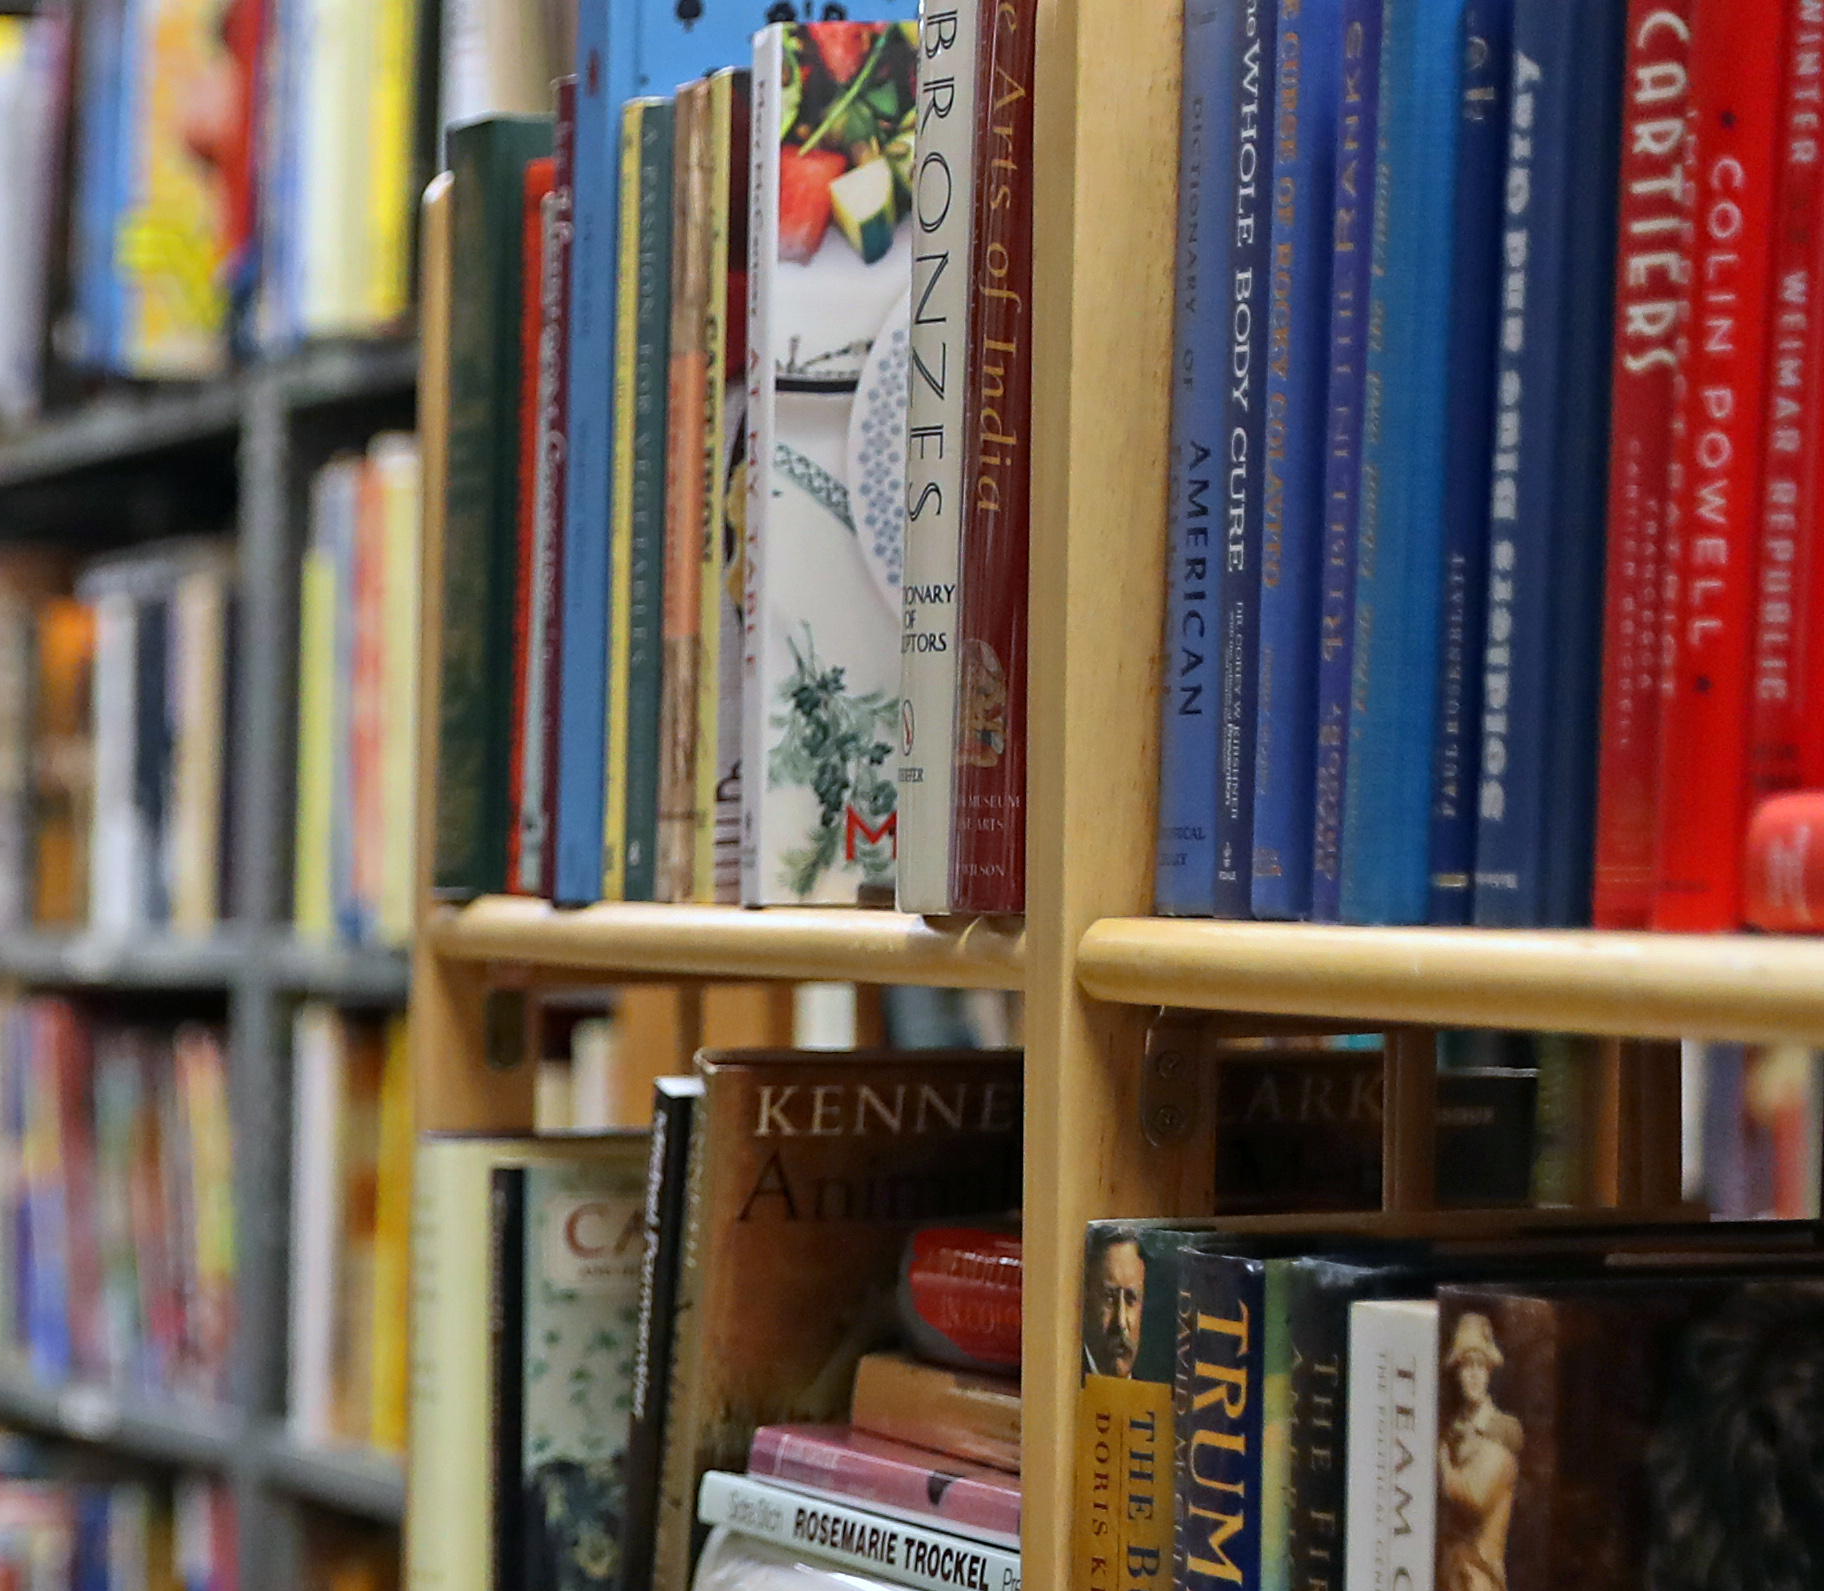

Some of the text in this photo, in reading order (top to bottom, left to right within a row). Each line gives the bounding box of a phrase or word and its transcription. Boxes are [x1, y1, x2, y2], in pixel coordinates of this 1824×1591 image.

[989, 66, 1025, 211] Arts
[1235, 39, 1260, 248] WHOLE
[1788, 0, 1822, 165] WINTER
[638, 166, 658, 325] PASSION
[908, 8, 957, 523] BRONZES
[1184, 96, 1204, 316] DICTIONARY
[1624, 9, 1690, 373] CARTIERS
[979, 242, 1021, 313] of
[1232, 268, 1253, 413] BODY
[1263, 32, 1301, 588] CURSE OF ROCKY COLAVITO
[977, 336, 1018, 513] India
[1687, 156, 1745, 647] COLIN POWELL
[1228, 427, 1248, 574] CURE
[1755, 270, 1807, 700] WEIMAR REPUBLIC
[902, 584, 956, 605] IONARY
[1179, 440, 1211, 717] AMERICAN
[754, 1081, 1016, 1137] KENNE
[1174, 1288, 1194, 1416] DAVID
[1310, 1353, 1340, 1474] THE
[1090, 1411, 1111, 1536] DORIS
[1126, 1410, 1156, 1521] THE
[1392, 1354, 1418, 1538] TEAM
[792, 1506, 897, 1566] ROSEMARIE
